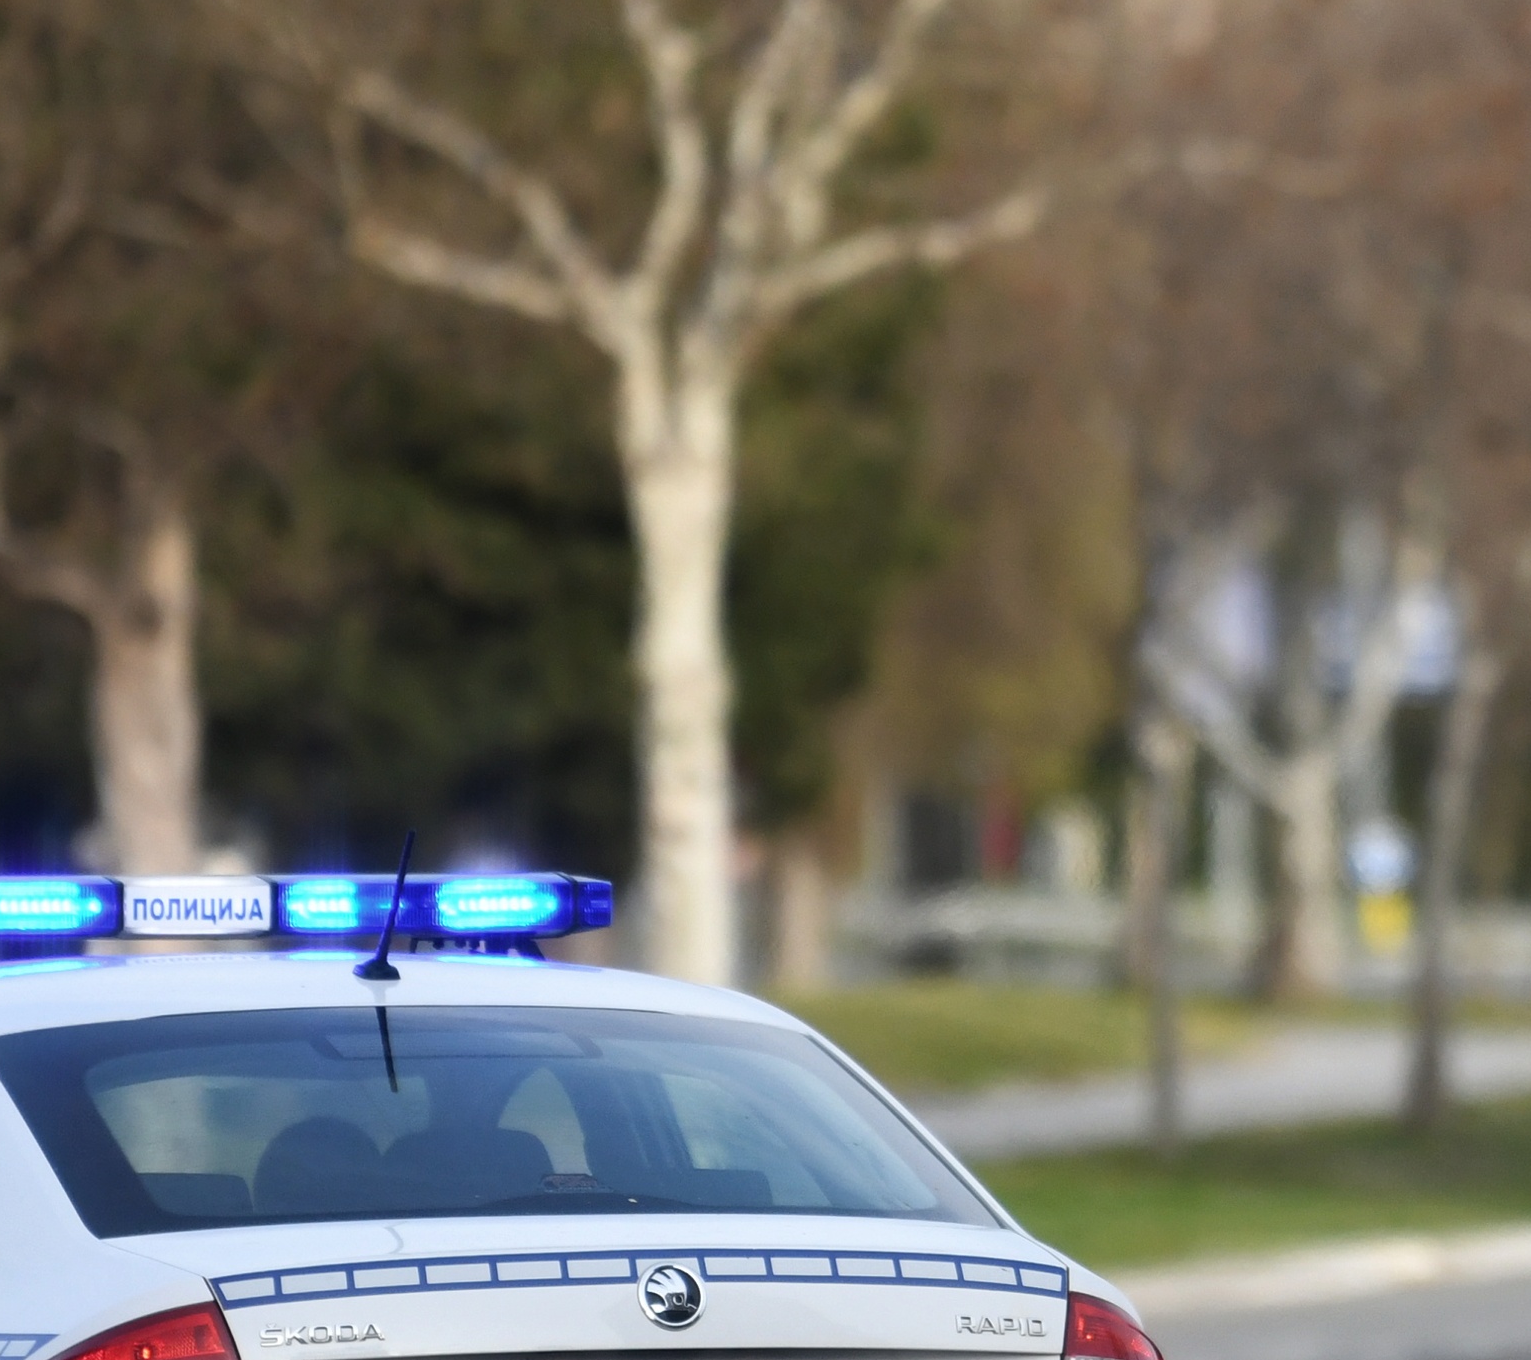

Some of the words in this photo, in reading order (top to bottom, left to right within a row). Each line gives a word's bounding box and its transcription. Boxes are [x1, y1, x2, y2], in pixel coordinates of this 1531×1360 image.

[133, 898, 263, 925] ПОЛИЦИЈА
[259, 1323, 385, 1347] ŠKODA
[955, 1315, 1047, 1337] RAPID
